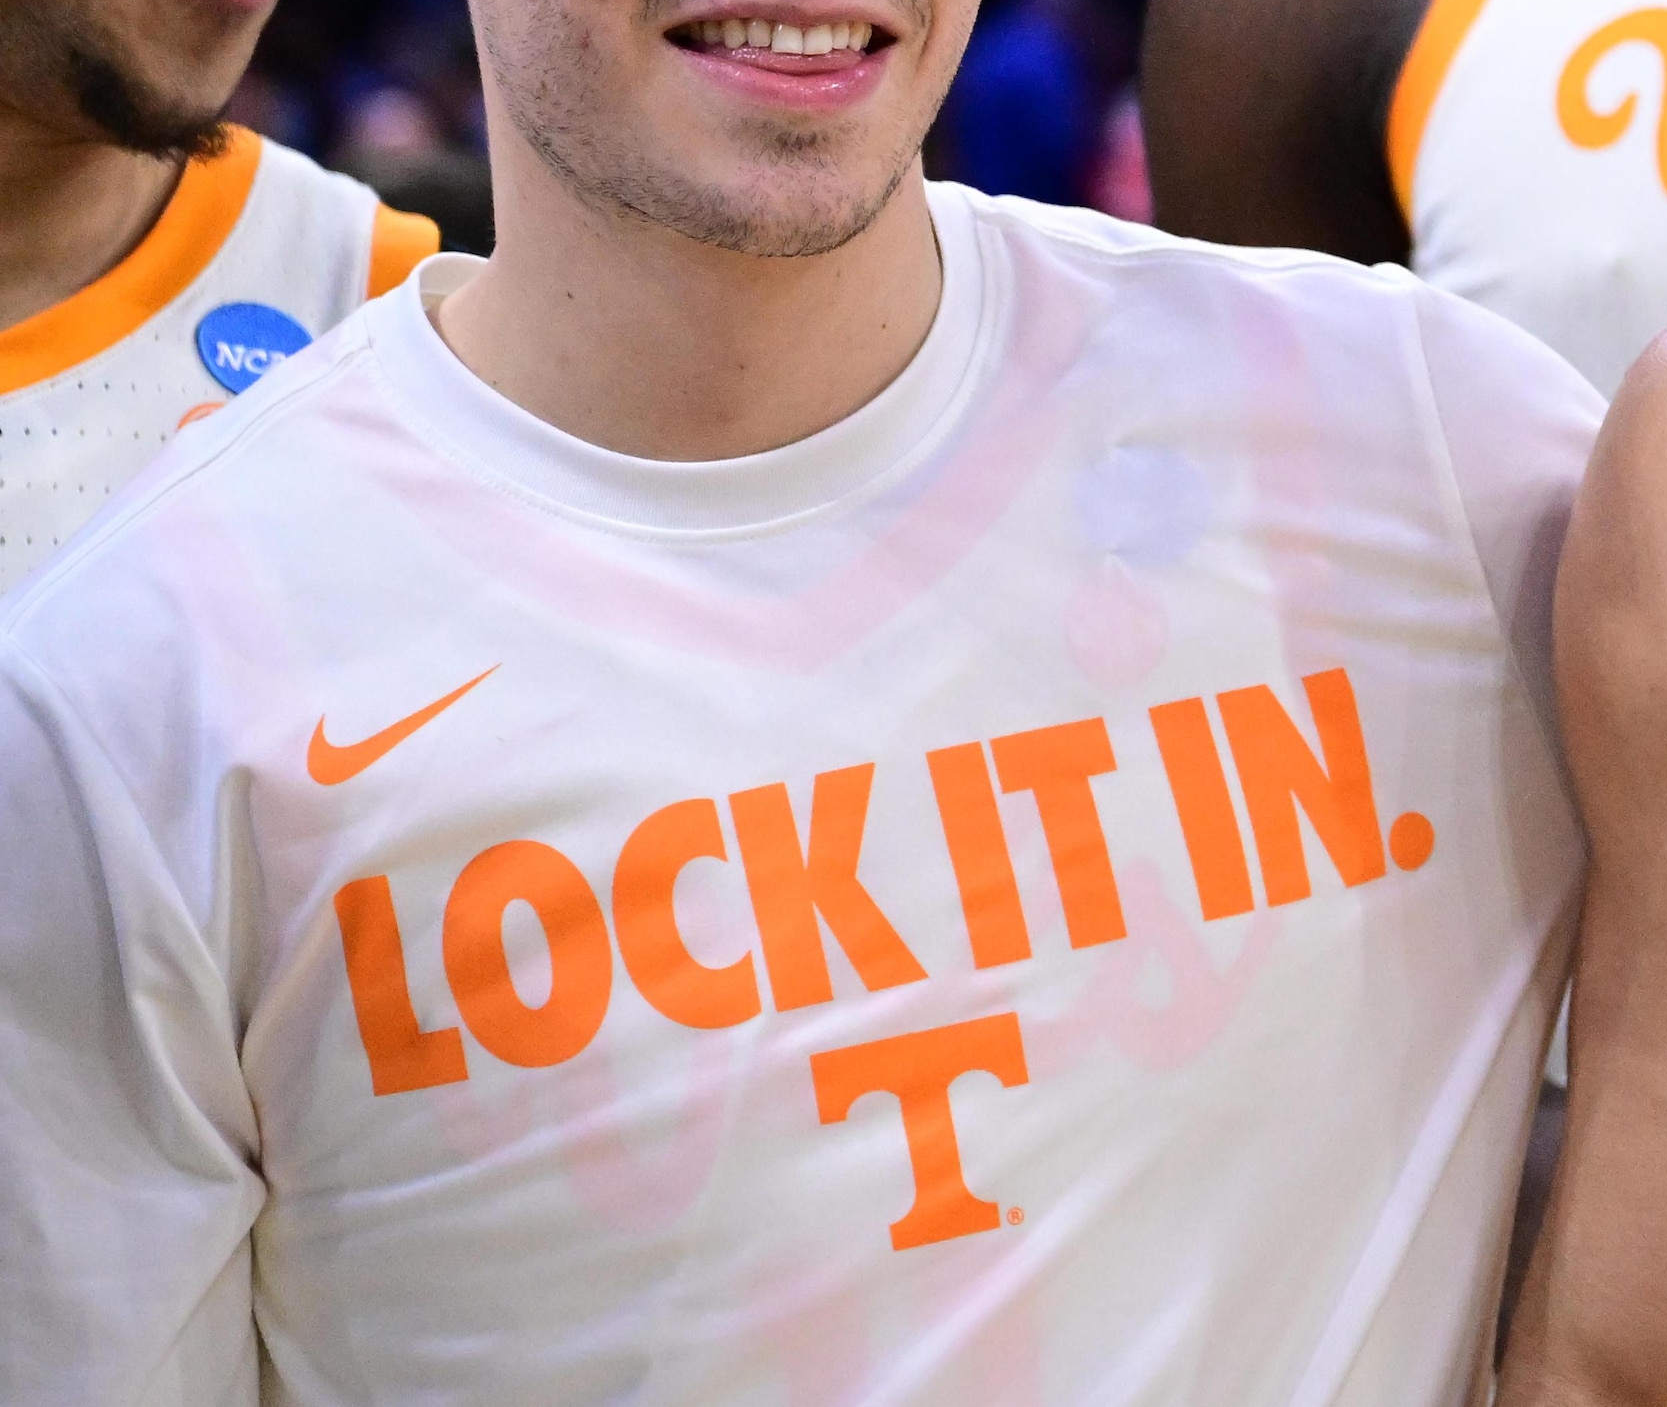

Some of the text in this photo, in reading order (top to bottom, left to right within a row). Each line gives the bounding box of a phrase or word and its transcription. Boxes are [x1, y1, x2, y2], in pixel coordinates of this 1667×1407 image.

[333, 763, 929, 1097] LOCK
[927, 717, 1128, 970] IT
[1148, 667, 1436, 922] IN.
[809, 1011, 1030, 1252] T
